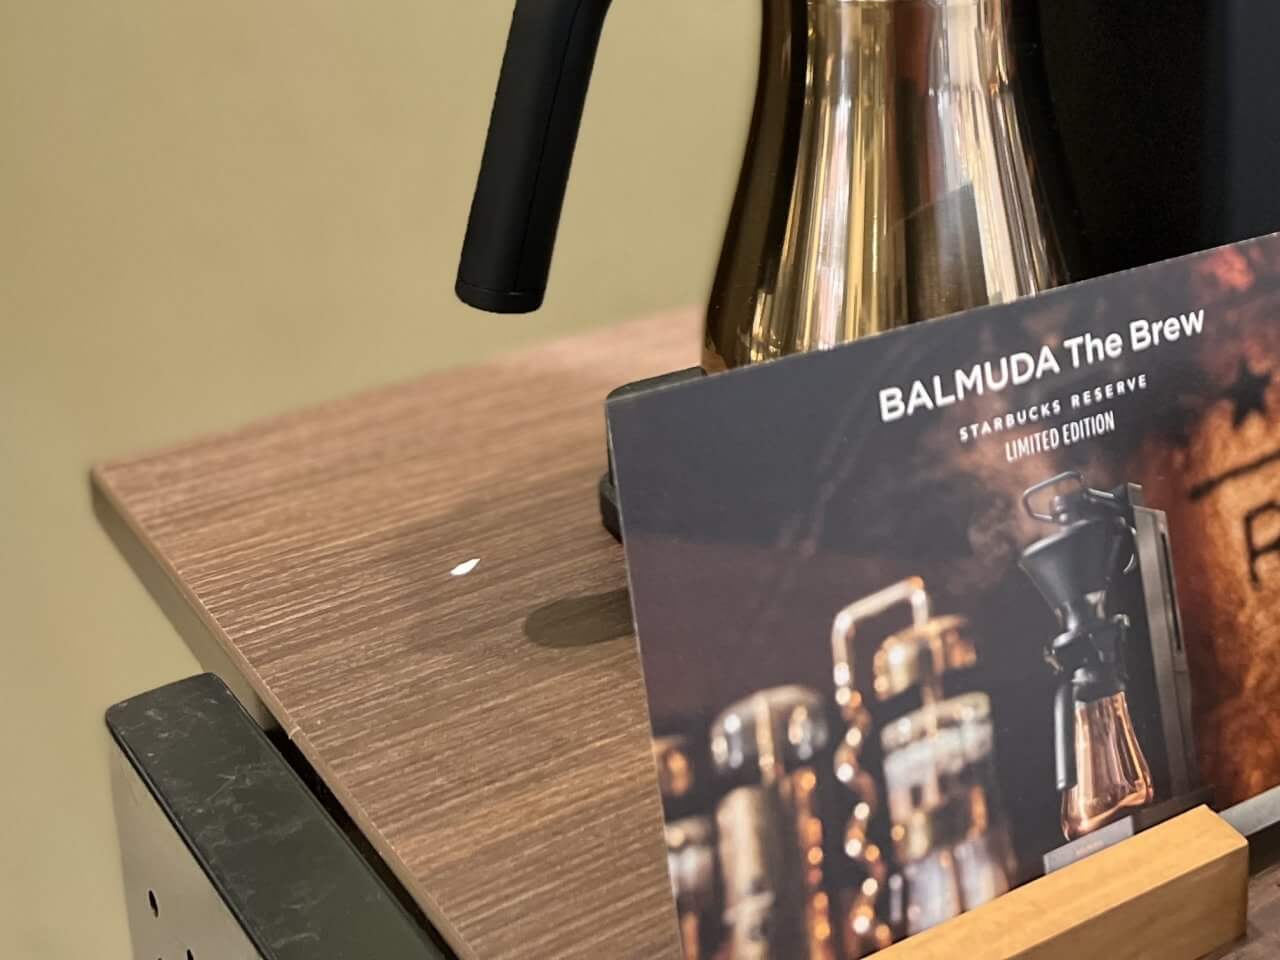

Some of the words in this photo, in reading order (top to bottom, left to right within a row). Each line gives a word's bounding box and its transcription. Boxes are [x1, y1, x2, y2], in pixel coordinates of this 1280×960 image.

[878, 344, 1060, 423] BALMUDA
[1064, 332, 1123, 369] The
[1129, 308, 1206, 352] Brew
[959, 399, 1061, 442] STARBUCKS
[1071, 373, 1148, 409] RESERVE
[1005, 426, 1059, 464] LIMITED
[1062, 411, 1116, 445] EDITION
